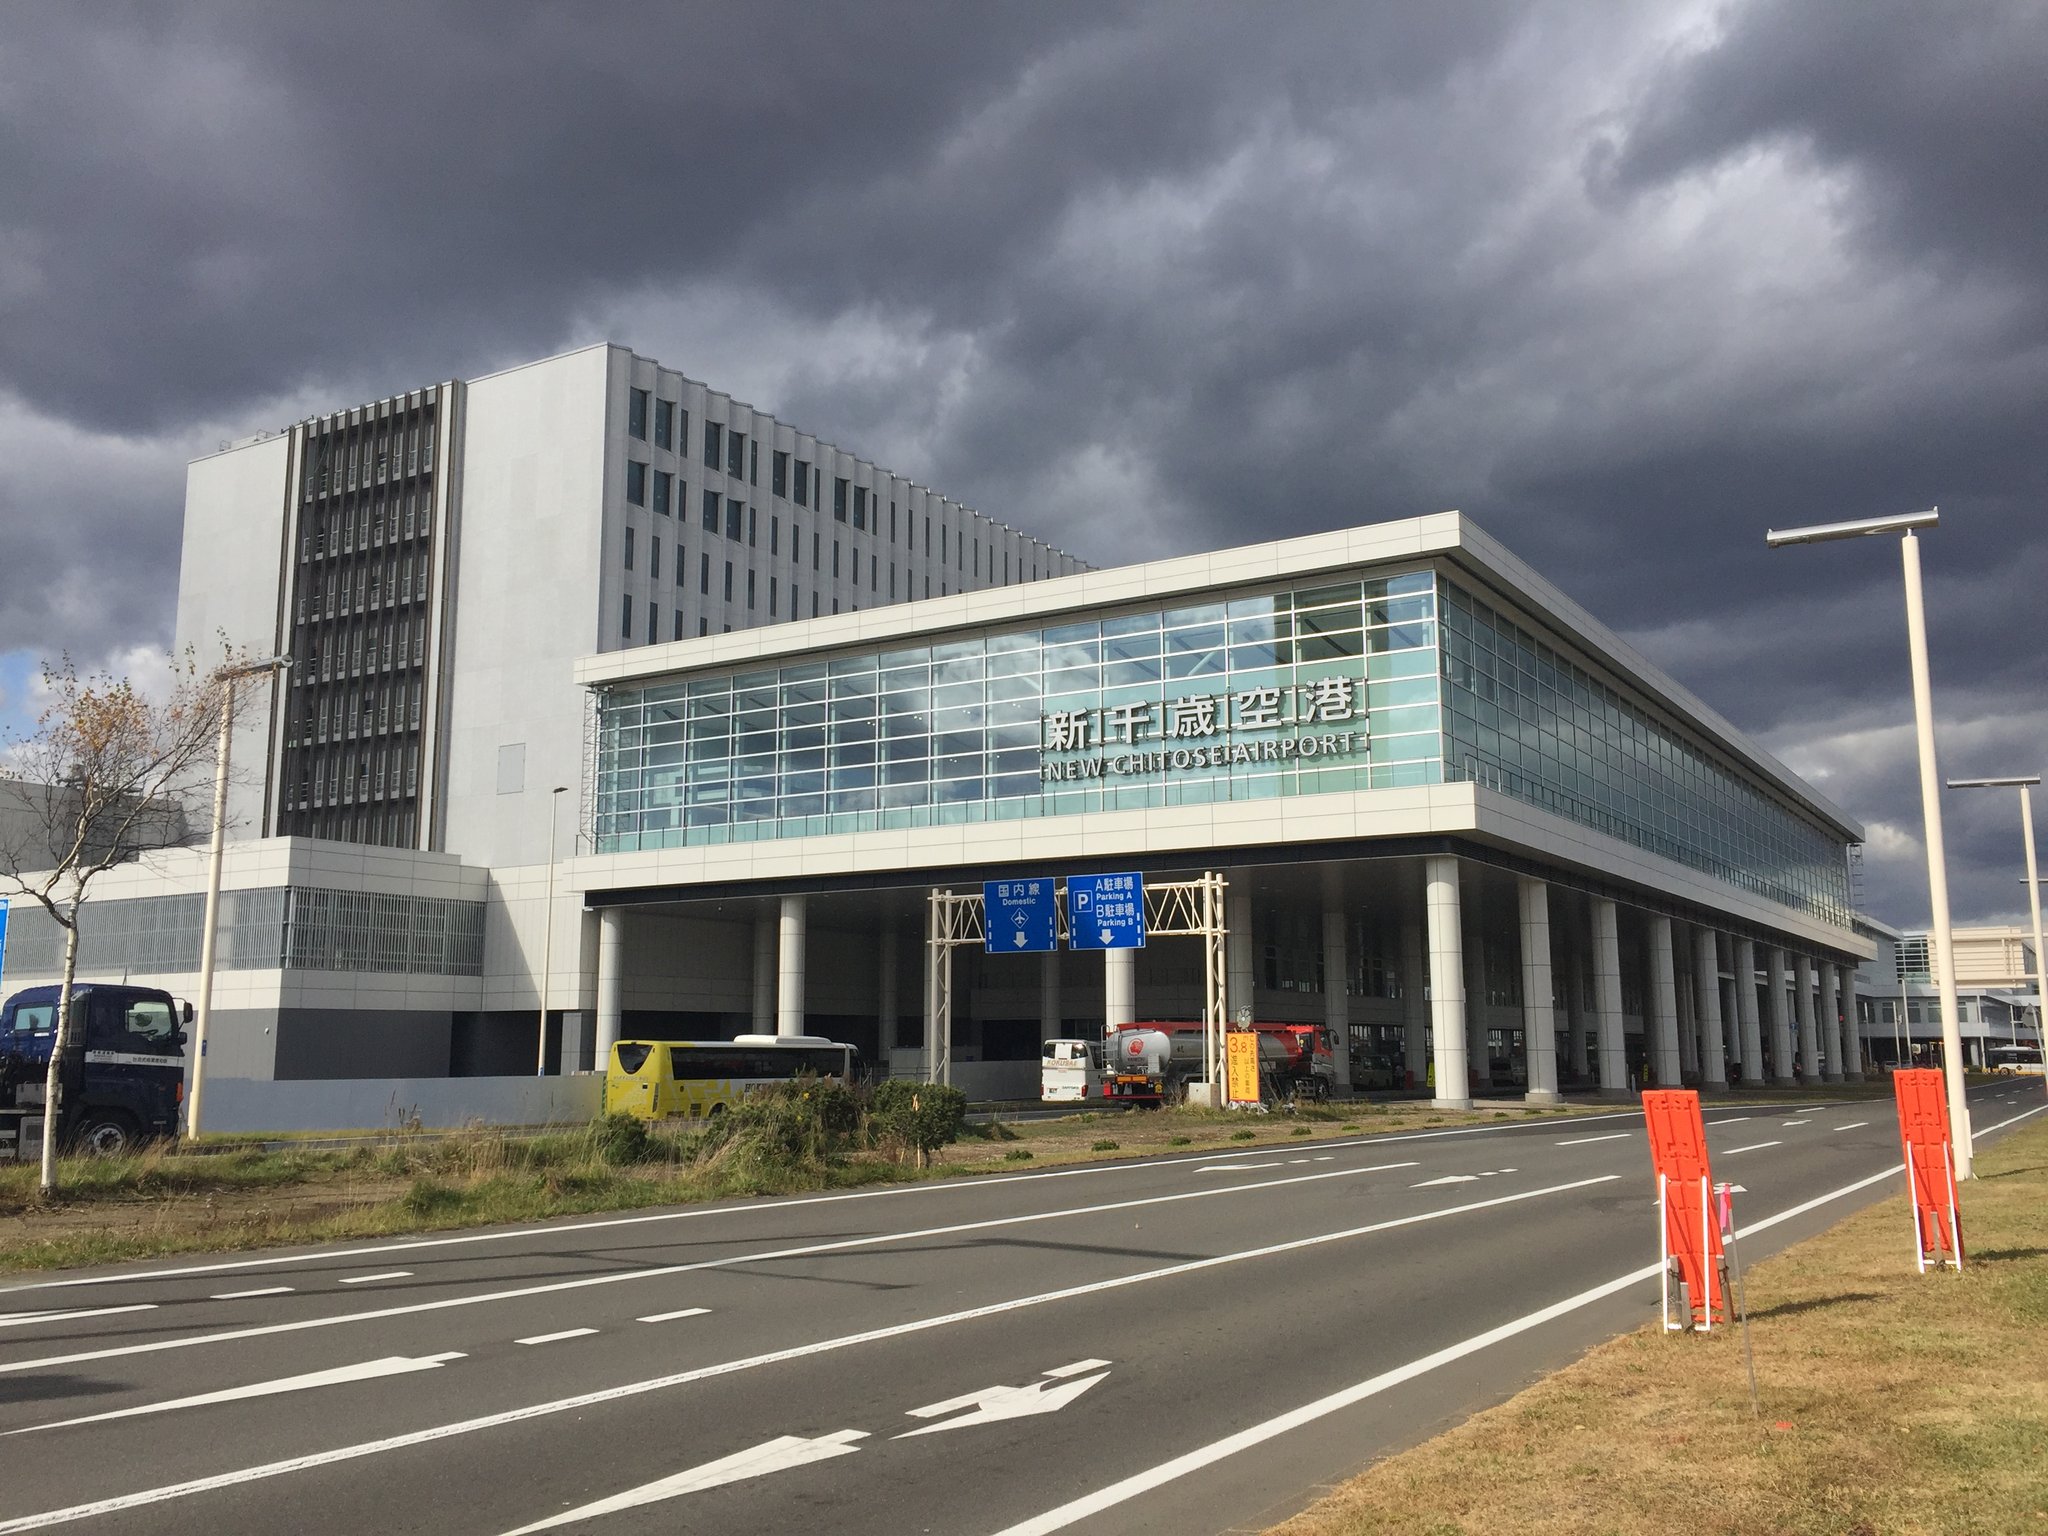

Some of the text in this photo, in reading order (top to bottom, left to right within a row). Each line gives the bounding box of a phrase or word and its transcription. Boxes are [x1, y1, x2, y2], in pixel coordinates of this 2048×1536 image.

[1048, 675, 1353, 751] 新千歳空港
[1047, 731, 1356, 781] NEW CHITOSE AIRPORT
[998, 882, 1041, 898] 国内線
[1095, 877, 1134, 892] A駐車場
[1002, 897, 1036, 906] Domestic
[1077, 893, 1089, 910] P
[1096, 892, 1133, 902] Parking A
[1096, 903, 1135, 918] B駐車場
[1097, 918, 1134, 928] Parking B
